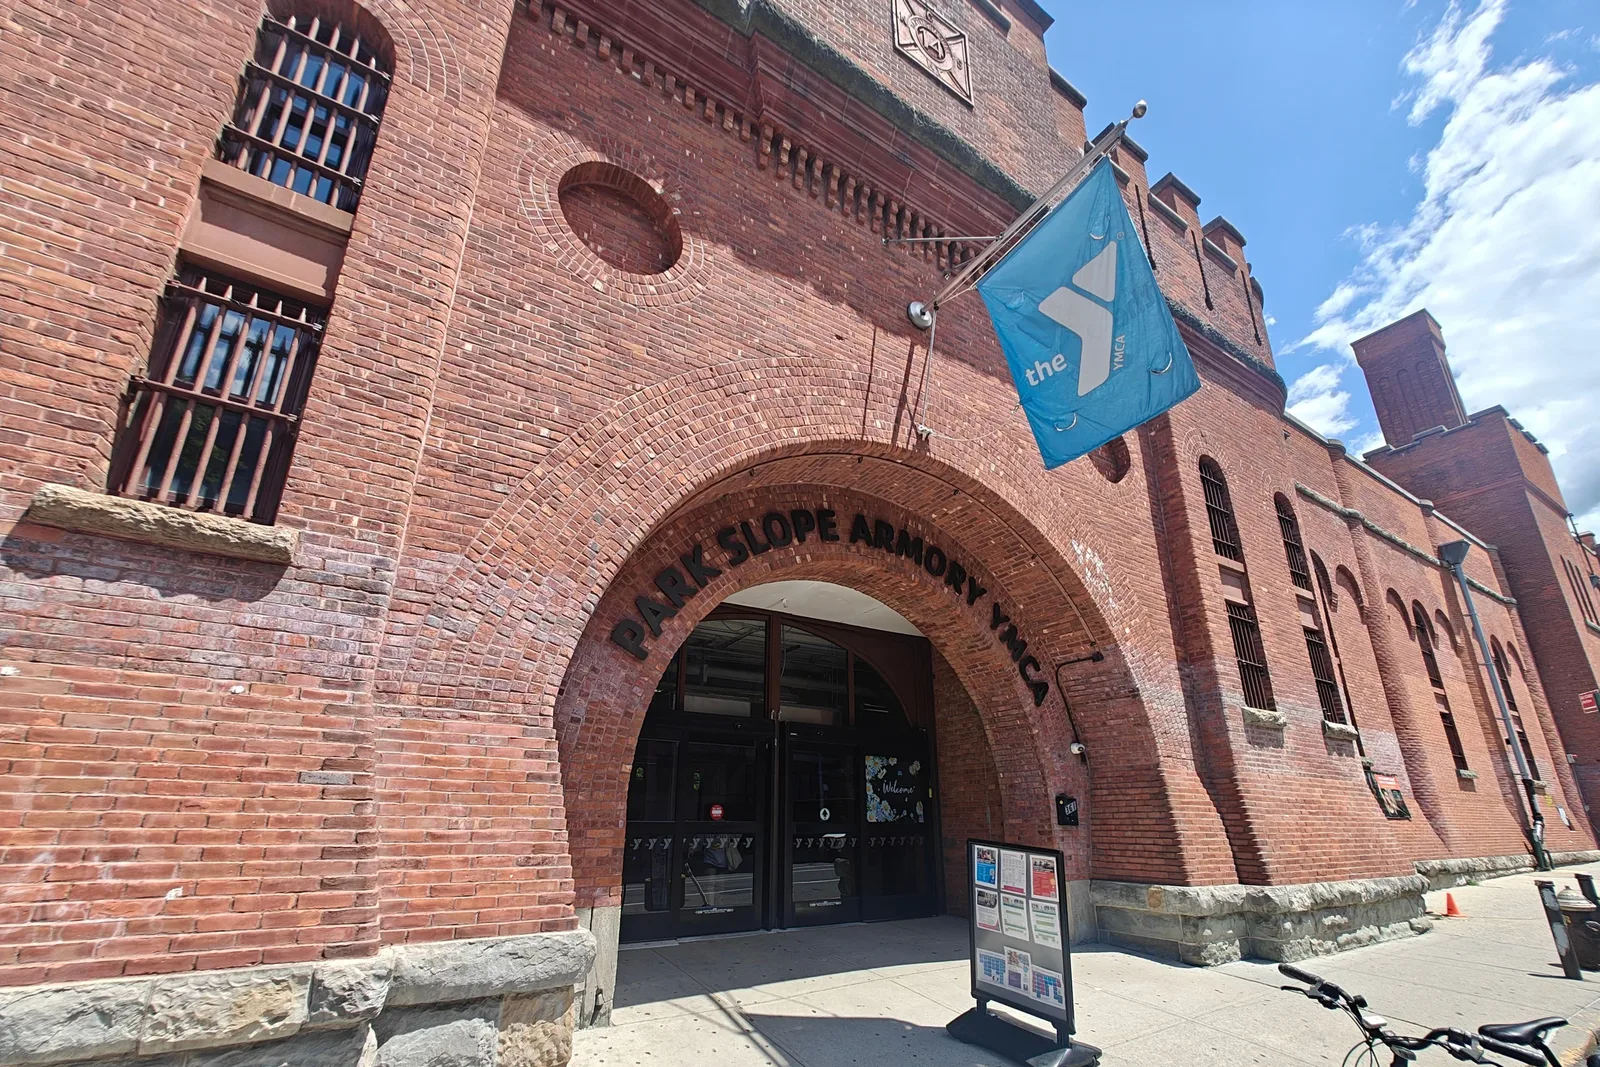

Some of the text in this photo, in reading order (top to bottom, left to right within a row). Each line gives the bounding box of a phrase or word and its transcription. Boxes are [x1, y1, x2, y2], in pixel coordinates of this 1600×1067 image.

[1025, 352, 1067, 387] the
[1113, 334, 1126, 371] YMCA
[611, 509, 1049, 707] PARK SLOPE ARMORY YMCA
[882, 779, 914, 794] Welcome
